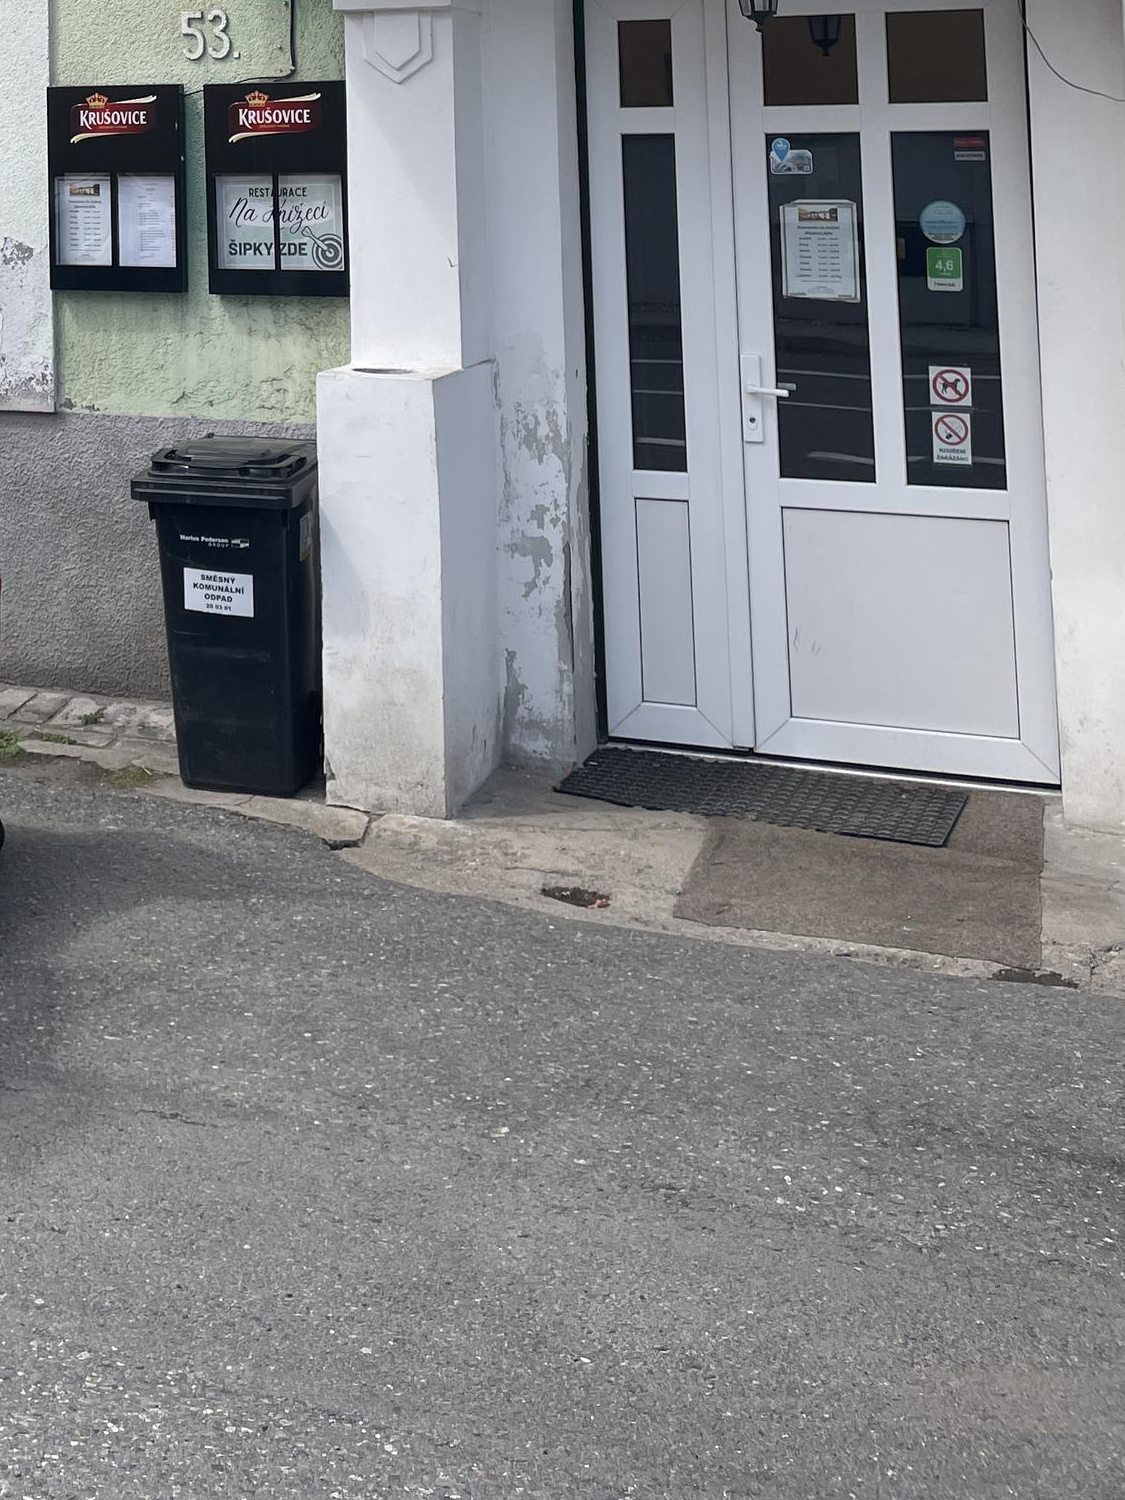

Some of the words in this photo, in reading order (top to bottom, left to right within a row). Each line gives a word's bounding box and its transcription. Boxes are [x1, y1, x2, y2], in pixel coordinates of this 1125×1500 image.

[79, 108, 147, 130] KRUŠOVICE
[238, 107, 311, 130] KRUŠOVICE
[228, 197, 258, 228] Na
[228, 239, 274, 256] ŠIPKY
[279, 242, 308, 256] ZDE
[935, 259, 954, 273] 4,6
[204, 593, 233, 603] ODPAD
